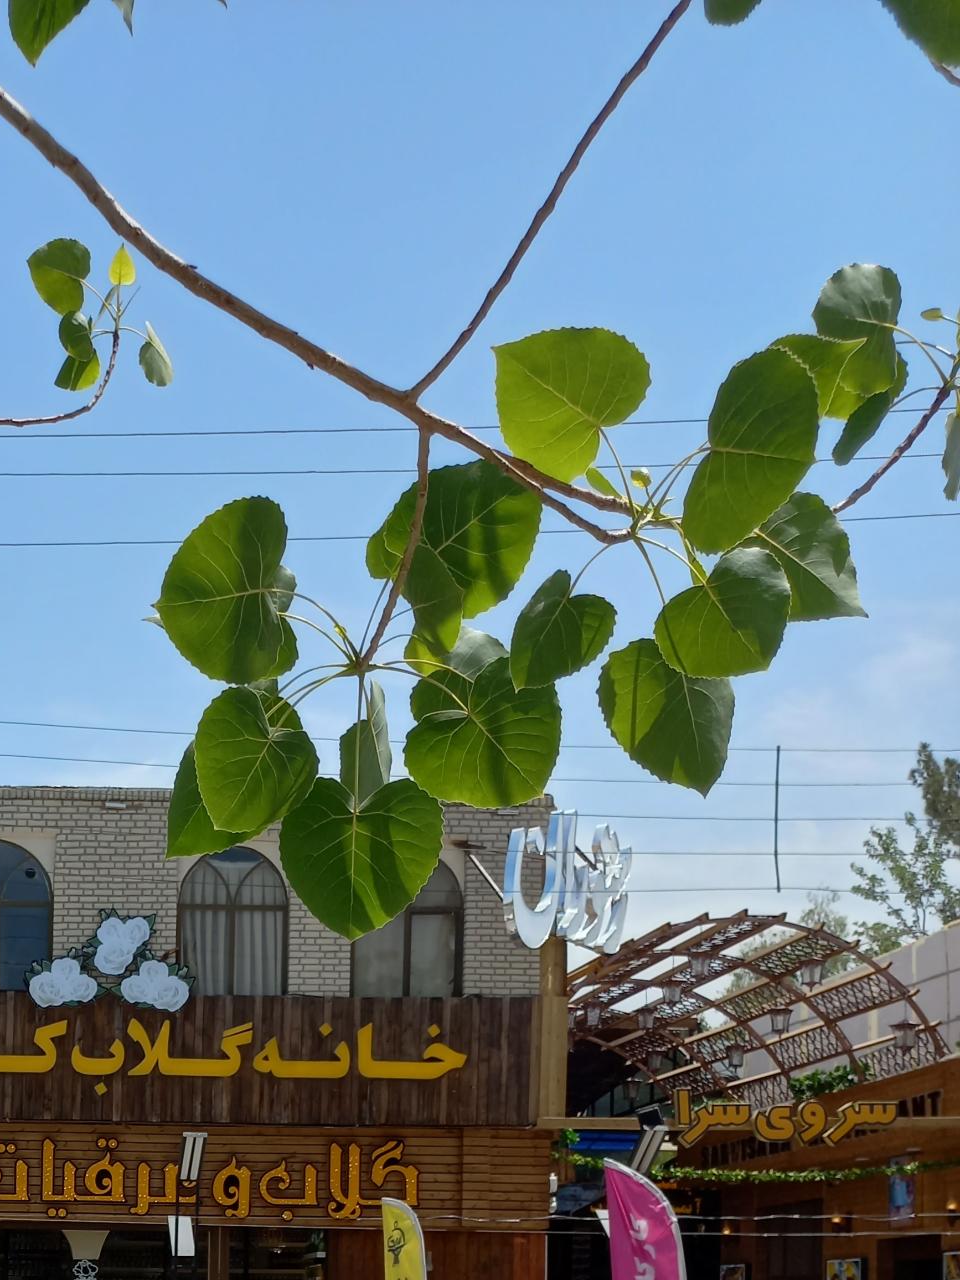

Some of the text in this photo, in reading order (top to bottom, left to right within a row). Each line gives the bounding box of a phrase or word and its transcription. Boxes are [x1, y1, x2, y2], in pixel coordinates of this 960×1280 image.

[71, 1017, 254, 1096] گلاب
[252, 1022, 468, 1080] خانه
[212, 1155, 252, 1219] و
[259, 1140, 419, 1222] گلاب
